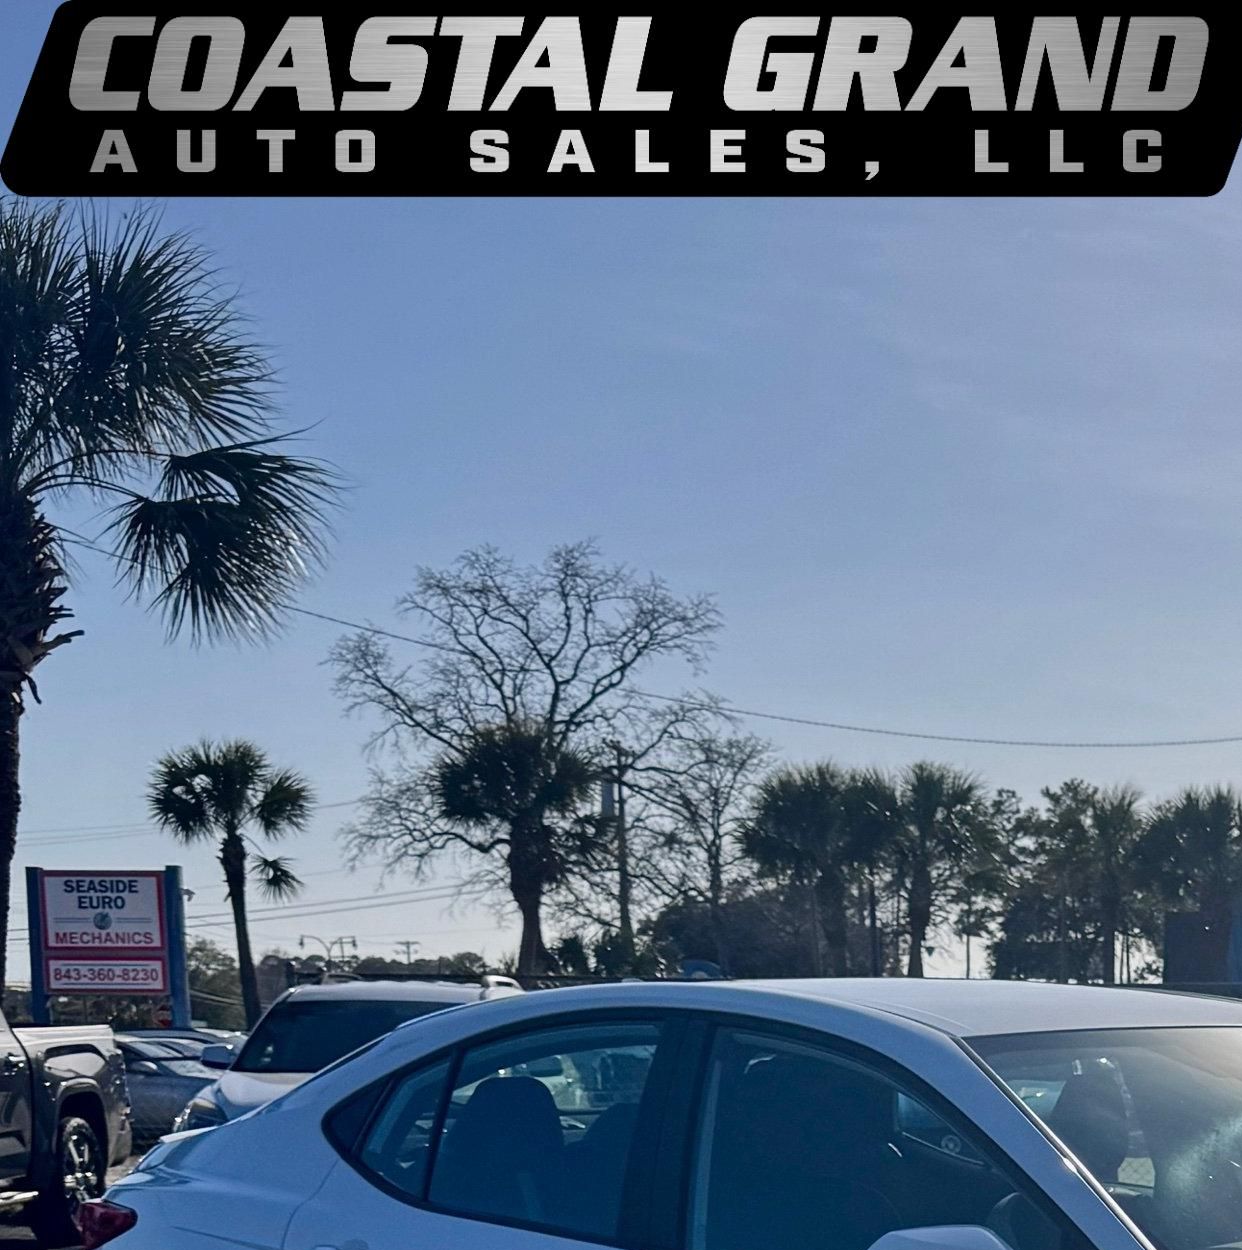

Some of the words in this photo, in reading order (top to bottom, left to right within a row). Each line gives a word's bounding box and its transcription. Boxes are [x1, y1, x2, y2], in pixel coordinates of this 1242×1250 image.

[64, 879, 139, 893] SEASIDE
[78, 896, 125, 910] EURO
[55, 931, 154, 945] MECHANICS
[54, 968, 158, 981] 843-360-8230
